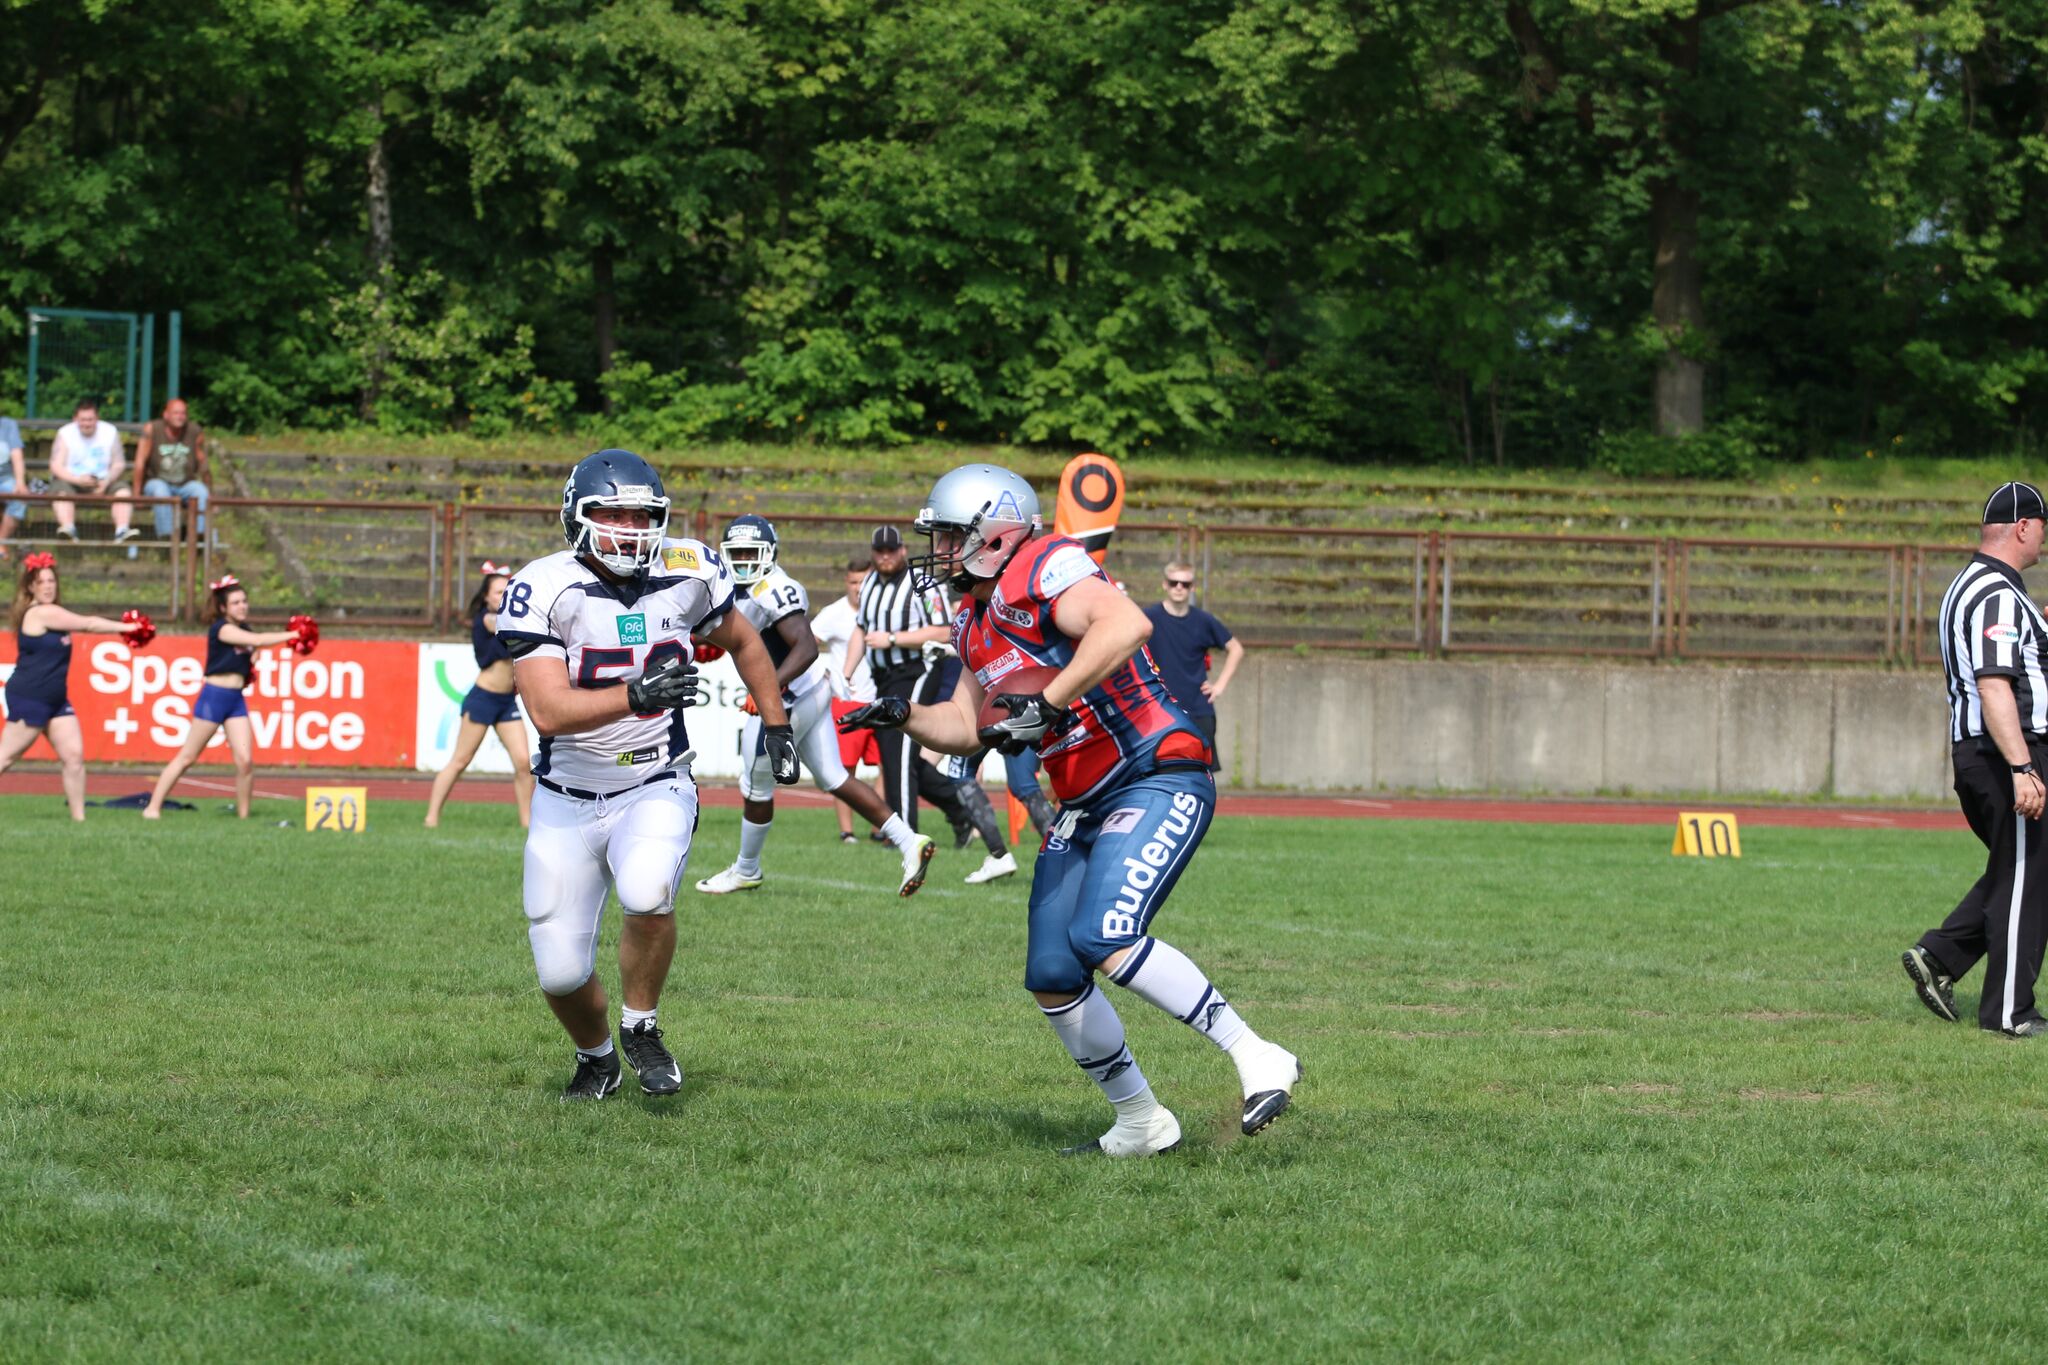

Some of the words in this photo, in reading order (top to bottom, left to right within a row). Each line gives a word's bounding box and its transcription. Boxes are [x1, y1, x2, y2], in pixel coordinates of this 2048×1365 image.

[771, 585, 800, 609] 12
[621, 633, 645, 644] Bank
[625, 621, 643, 634] psd
[89, 641, 365, 705] Spetion
[151, 696, 365, 752] Svice
[314, 795, 358, 832] 20
[1689, 818, 1732, 857] 10
[1102, 791, 1198, 939] Buderus
